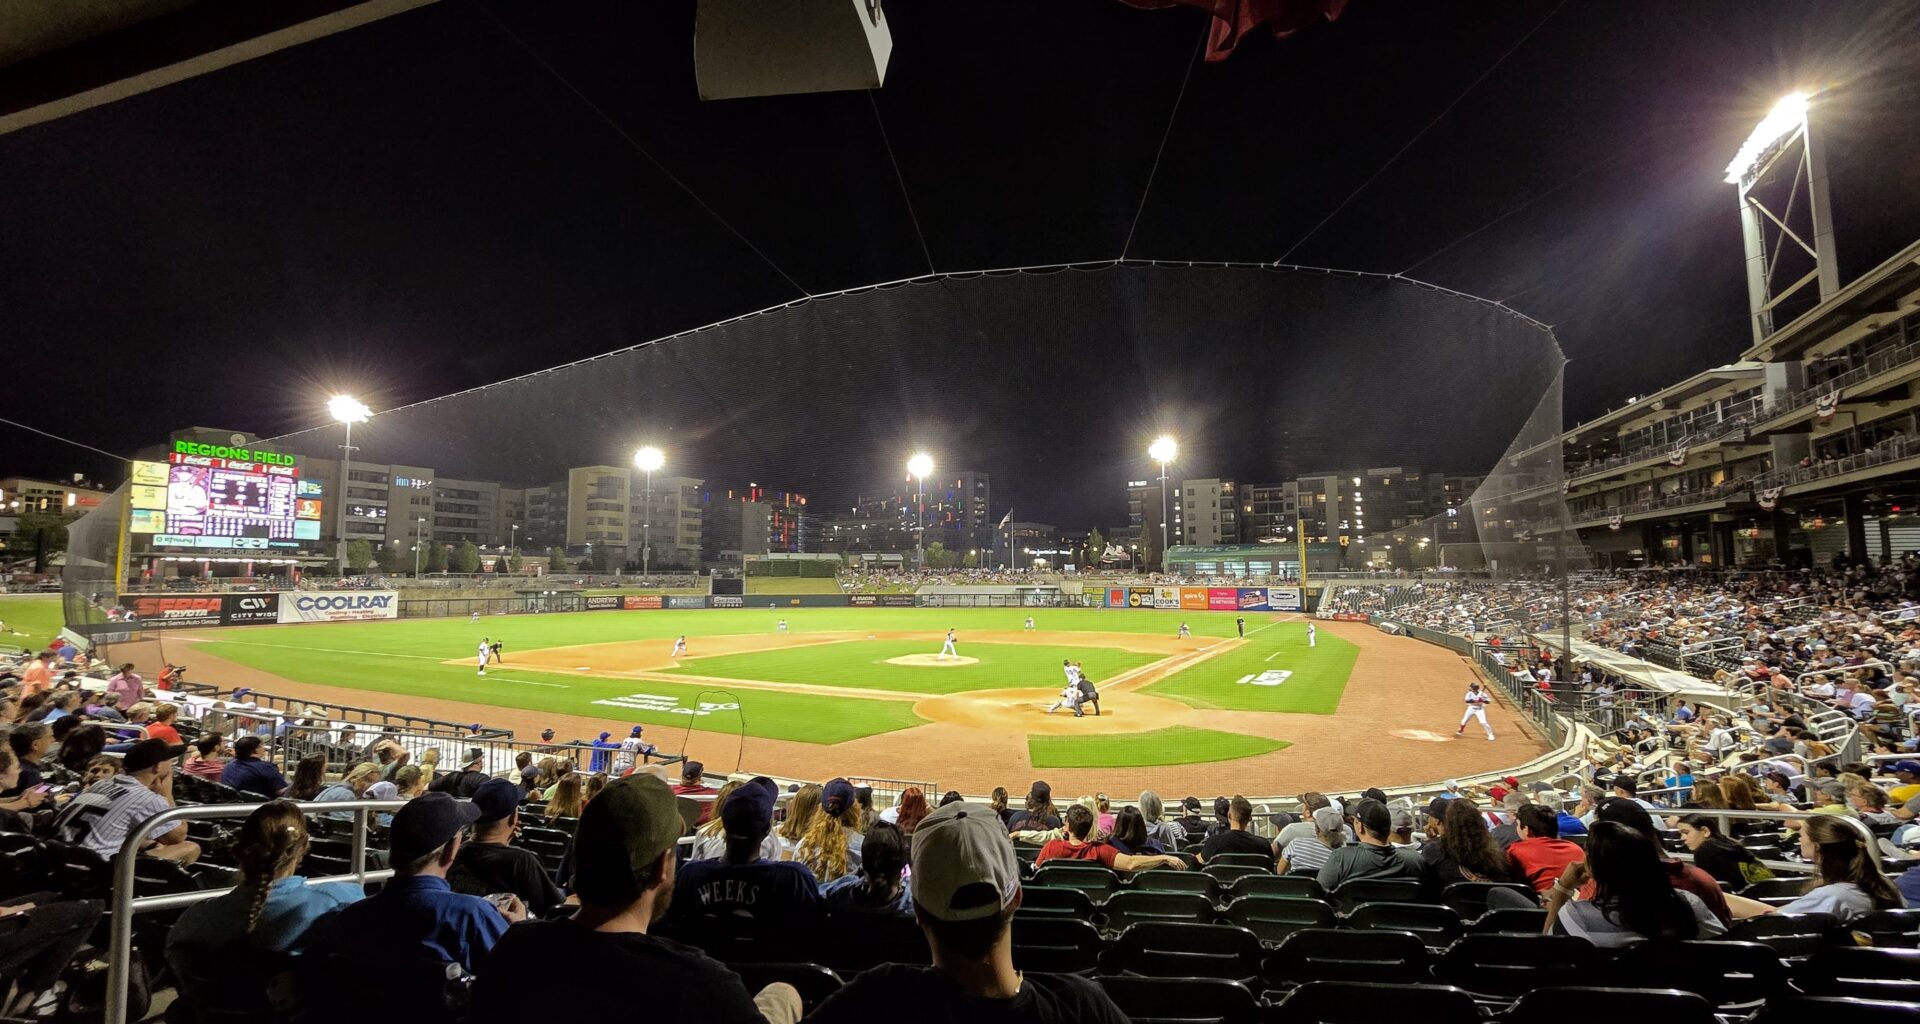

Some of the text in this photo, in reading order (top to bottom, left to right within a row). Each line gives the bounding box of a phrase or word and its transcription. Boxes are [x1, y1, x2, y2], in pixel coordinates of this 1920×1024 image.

[175, 440, 295, 466] REGIONS FIELD
[136, 598, 222, 616] SERRA
[296, 595, 393, 611] COOLRAY
[164, 609, 208, 617] TOYOTA
[697, 880, 760, 905] WEEKS
